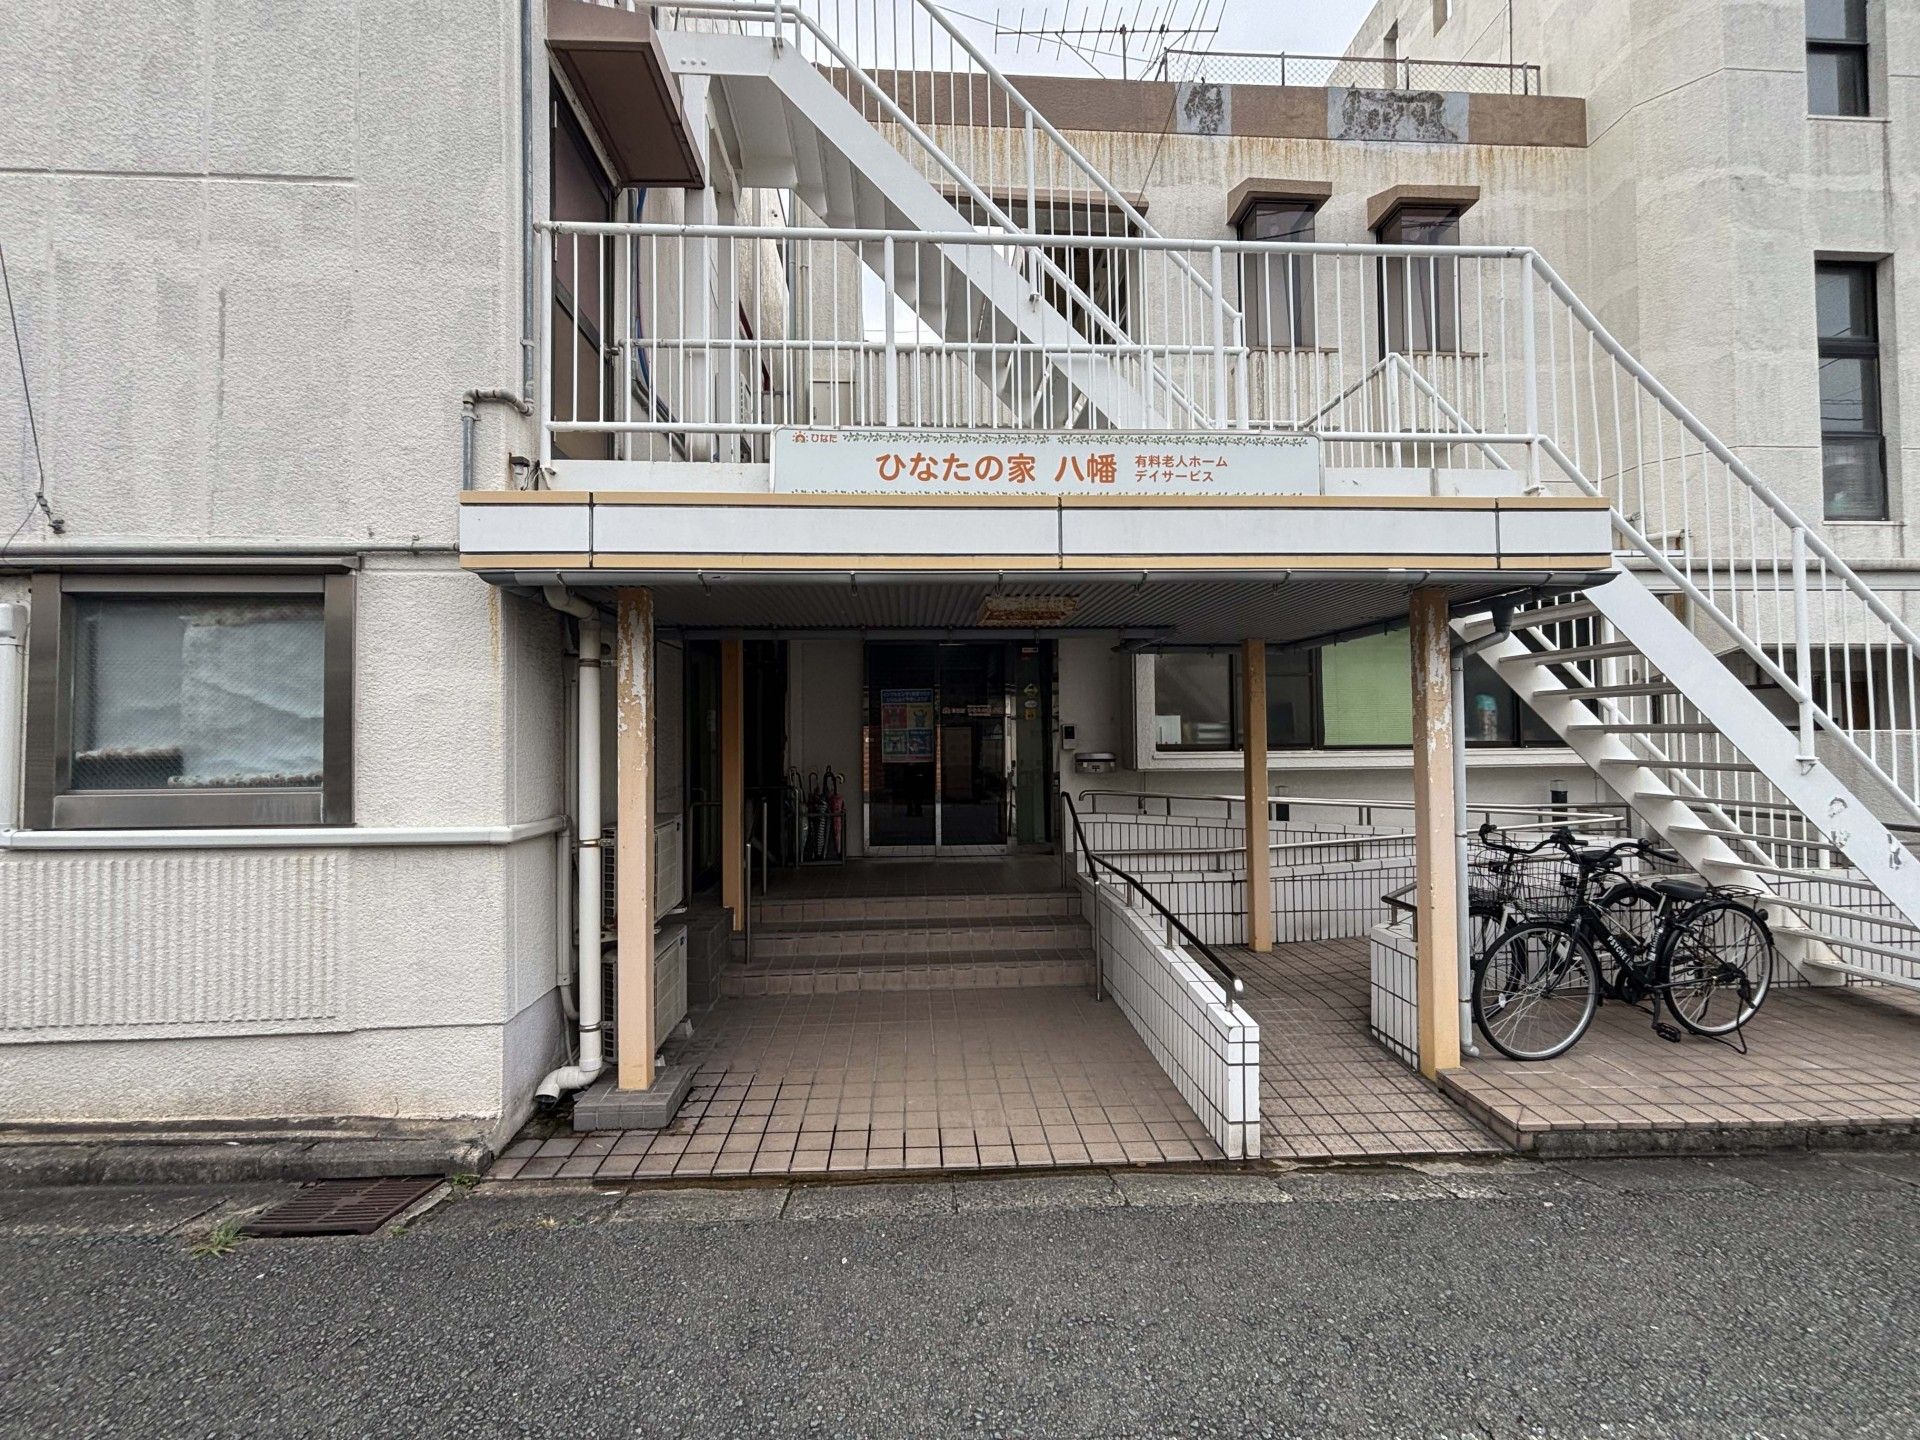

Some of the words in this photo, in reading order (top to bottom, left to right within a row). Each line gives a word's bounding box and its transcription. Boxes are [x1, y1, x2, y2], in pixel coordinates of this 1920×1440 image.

[810, 434, 838, 443] ひなた
[876, 452, 1036, 483] ひなたの家
[1054, 453, 1117, 483] 八幡
[1135, 455, 1228, 468] 有料老人ホーム
[1135, 470, 1214, 482] デイサービス
